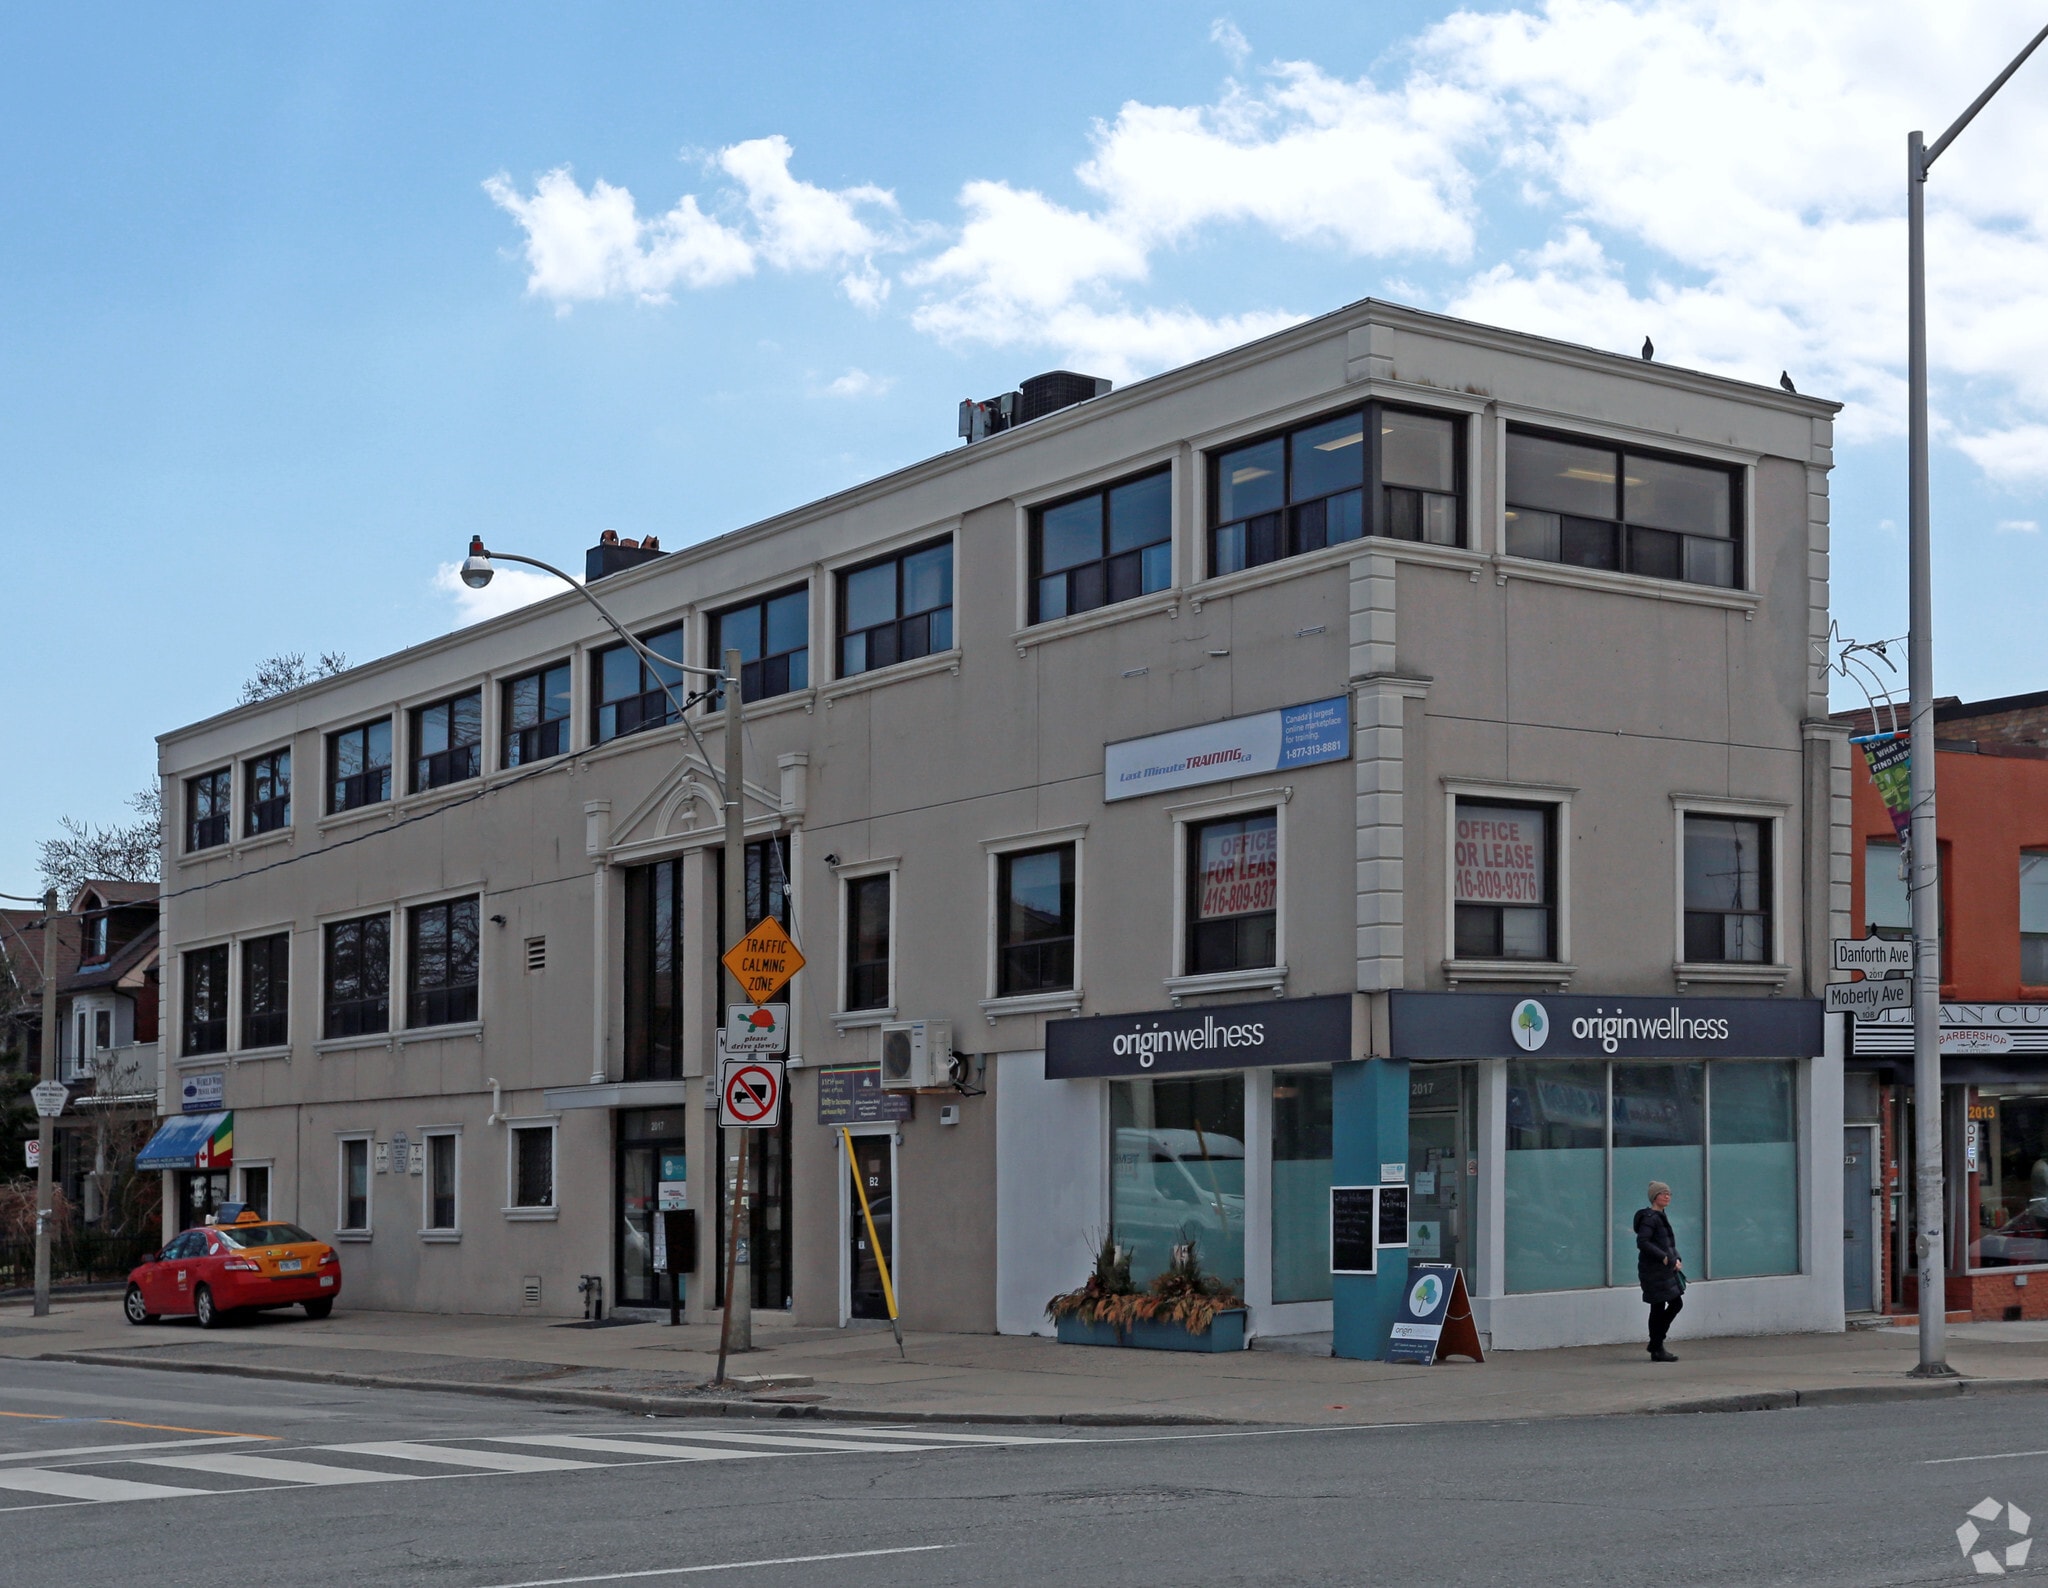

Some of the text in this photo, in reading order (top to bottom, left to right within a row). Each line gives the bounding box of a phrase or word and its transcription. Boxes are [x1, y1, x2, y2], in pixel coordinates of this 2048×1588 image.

[1285, 708, 1334, 724] Canada's largest
[1285, 718, 1341, 734] online marketplace
[1286, 741, 1341, 759] 1-877-313-8881
[1876, 738, 1911, 758] WHAT YO
[1872, 749, 1911, 773] FIND HER
[1120, 771, 1142, 782] Last
[1457, 820, 1520, 841] OFFICE
[1221, 833, 1276, 857] OFFICE
[1455, 841, 1535, 869] OR LEASE
[1207, 852, 1276, 885] FOR LEAS
[1455, 870, 1537, 900] 16-809-9376
[1203, 879, 1276, 914] 416-809-937
[746, 938, 788, 954] TRAFFIC
[1839, 945, 1909, 963] Danforth Ave
[742, 957, 786, 973] CALMING
[1869, 971, 1883, 979] 2017
[748, 977, 774, 991] ZONE
[1831, 986, 1904, 1006] Moberly Ave
[754, 1042, 780, 1050] slowly
[1938, 1030, 2007, 1045] BARBERSHOP
[1412, 1083, 1434, 1095] 2017
[1968, 1106, 1995, 1119] 2013
[1967, 1125, 1976, 1169] OPEN
[869, 1177, 879, 1187] B2
